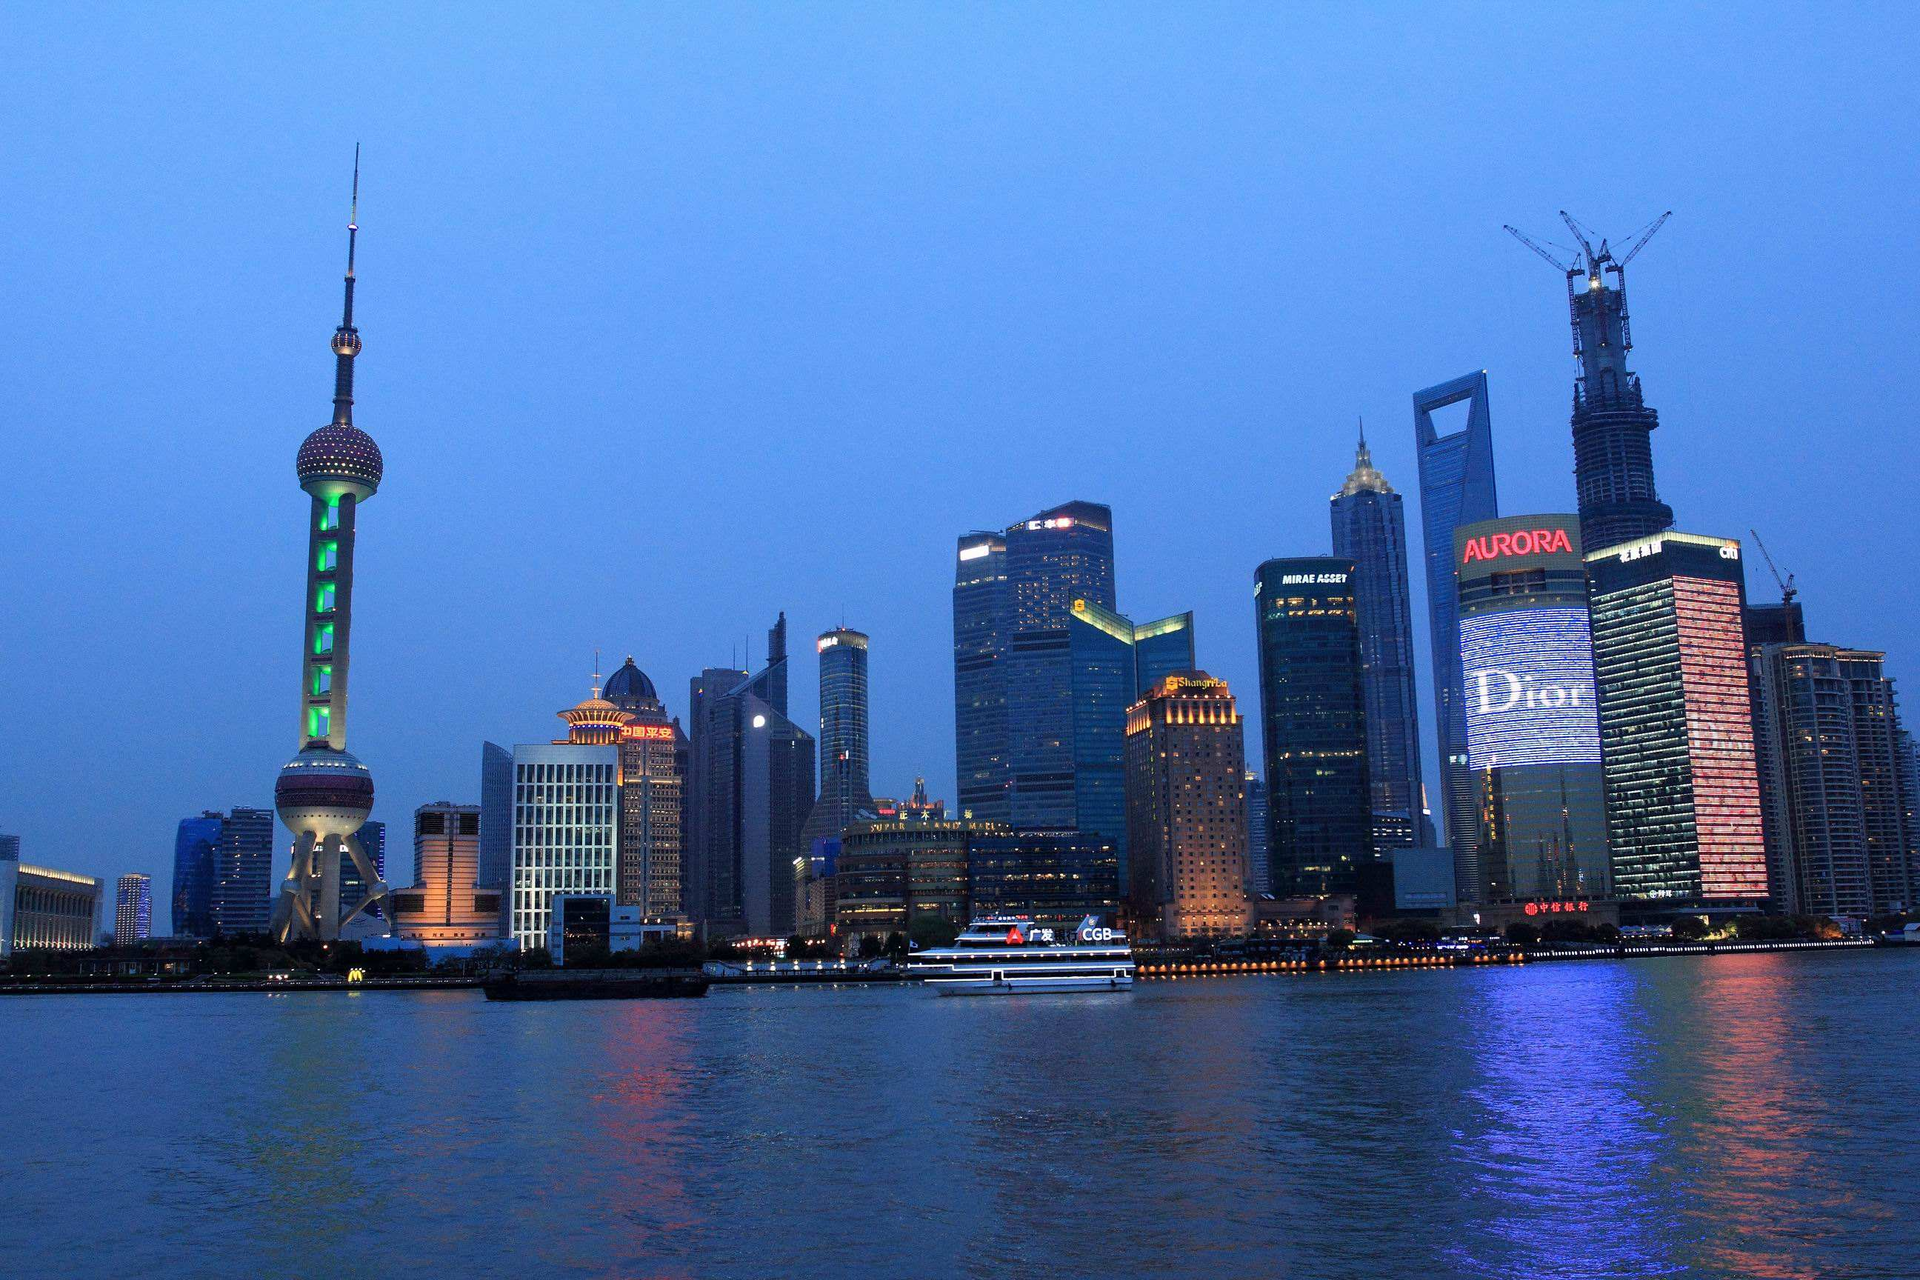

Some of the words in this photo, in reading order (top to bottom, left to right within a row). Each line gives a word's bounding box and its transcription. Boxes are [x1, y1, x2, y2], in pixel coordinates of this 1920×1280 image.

[1463, 529, 1573, 564] AURORA
[1719, 545, 1739, 560] citi
[1282, 574, 1315, 585] MIRAE
[1317, 573, 1348, 584] ASSET
[1473, 668, 1587, 713] Dior
[620, 725, 672, 738] 中国平安
[1082, 927, 1112, 941] CGB
